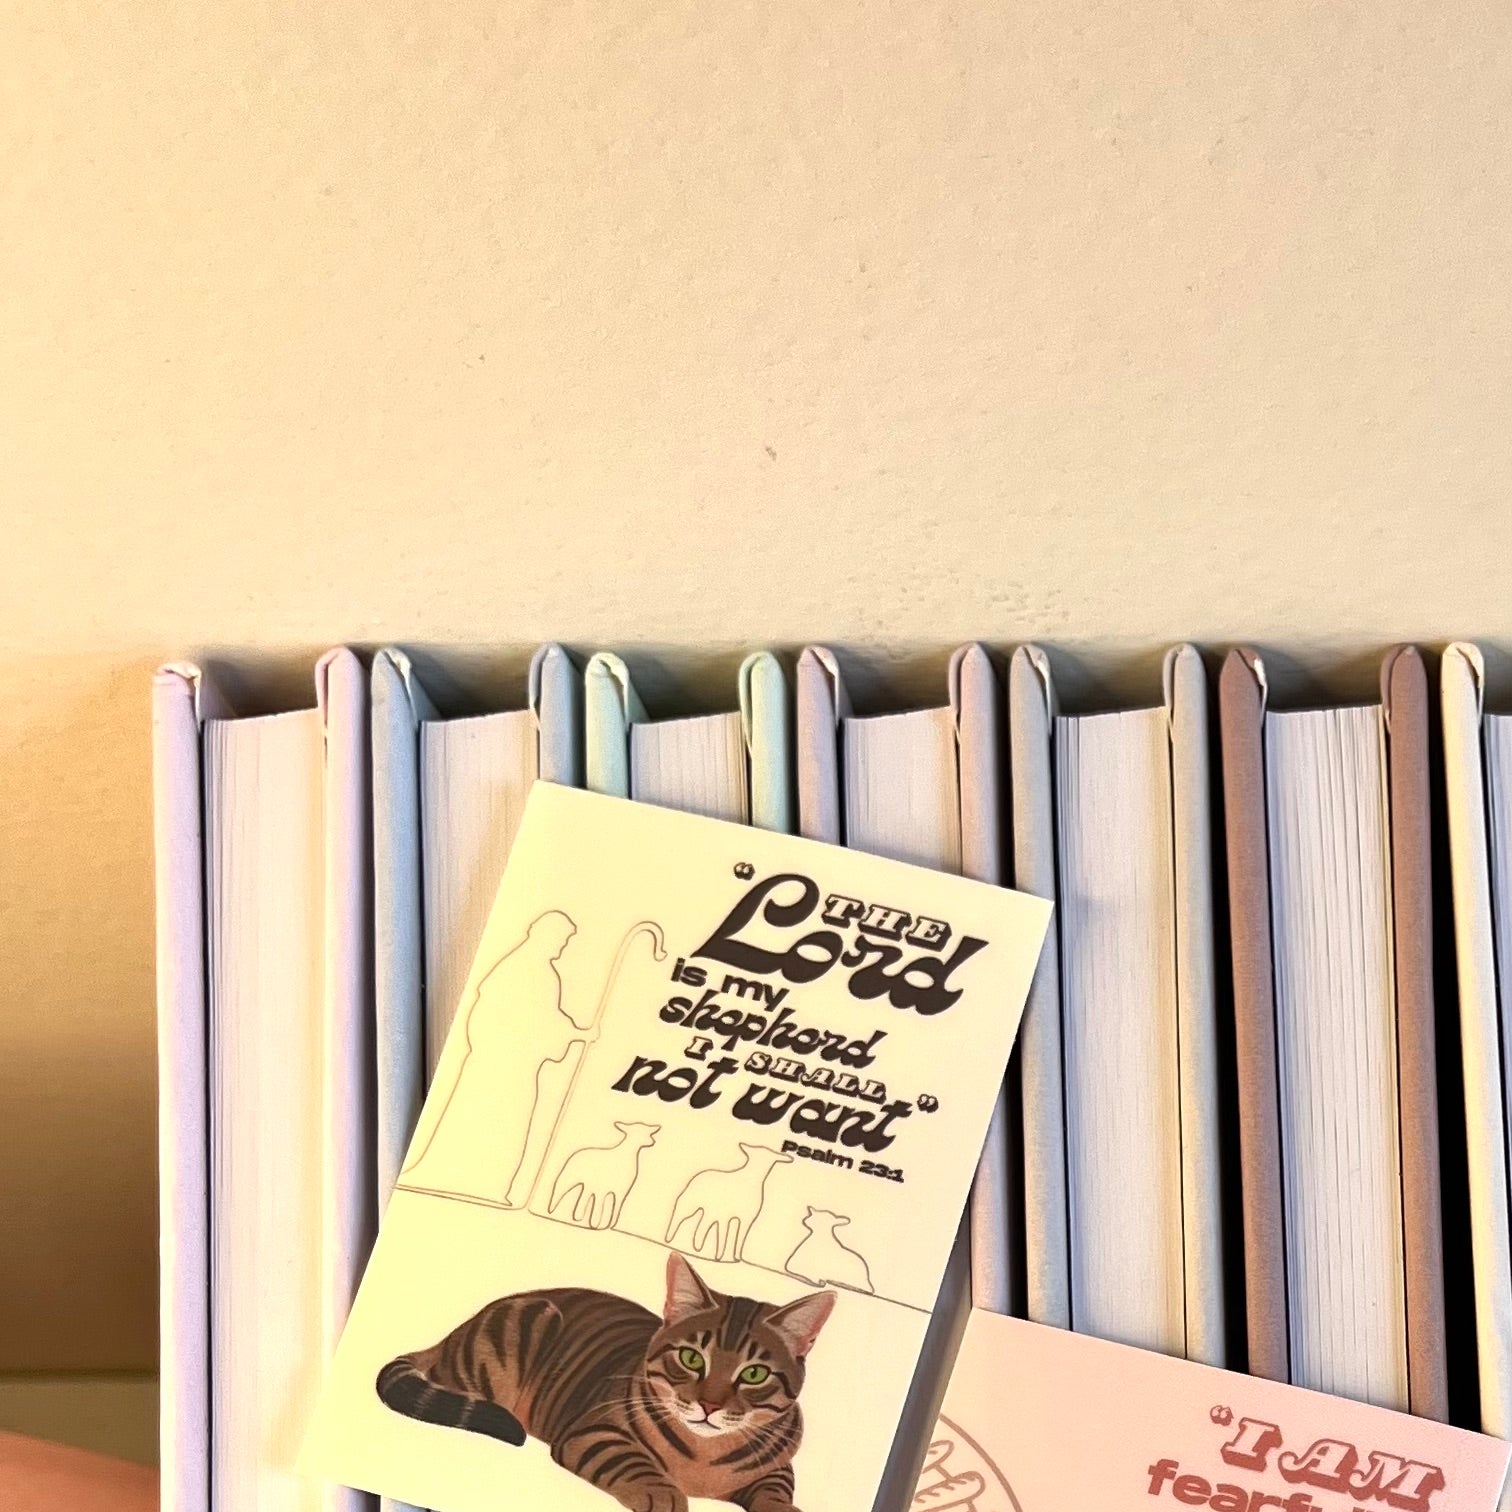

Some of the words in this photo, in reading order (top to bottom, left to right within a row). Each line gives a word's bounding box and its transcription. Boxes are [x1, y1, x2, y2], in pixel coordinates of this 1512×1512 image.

[821, 894, 952, 952] THE
[671, 957, 707, 987] is
[722, 974, 789, 1012] my
[611, 1055, 739, 1109] not
[684, 1035, 714, 1061] I
[744, 1051, 887, 1104] SHALL
[781, 1140, 853, 1169] Psalm
[858, 1160, 904, 1183] 23:1
